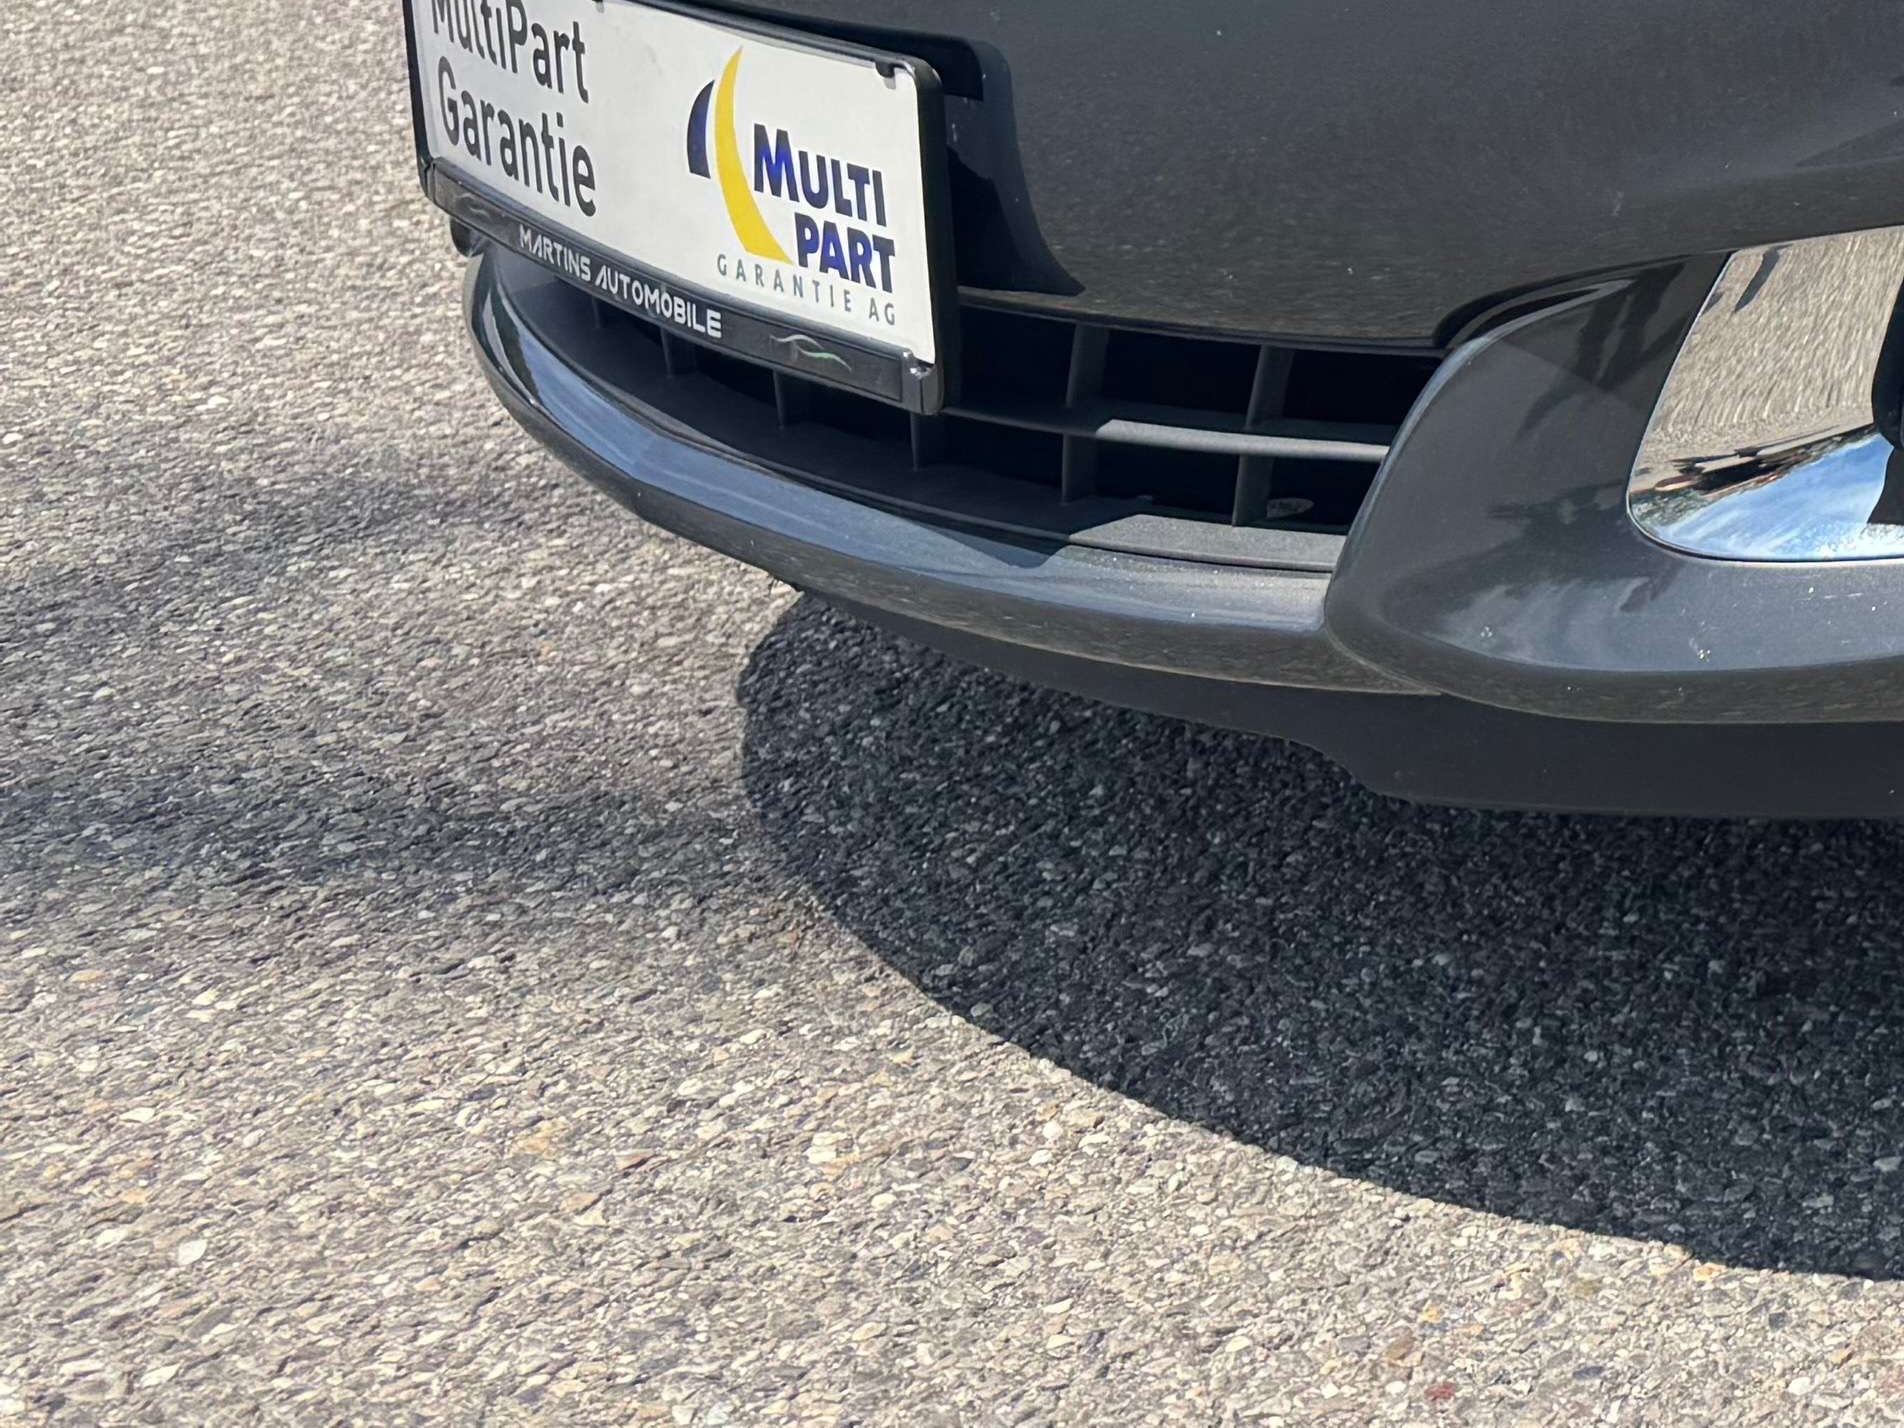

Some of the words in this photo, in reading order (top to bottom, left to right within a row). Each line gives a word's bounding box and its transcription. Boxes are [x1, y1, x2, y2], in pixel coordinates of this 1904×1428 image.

[437, 55, 597, 218] Garantie
[753, 123, 888, 228] MULTI
[519, 224, 591, 283] MARTINS
[595, 264, 723, 339] AUTOMOBILE
[716, 253, 852, 313] GARANTIE
[868, 297, 896, 326] AG
[793, 211, 896, 294] PART
